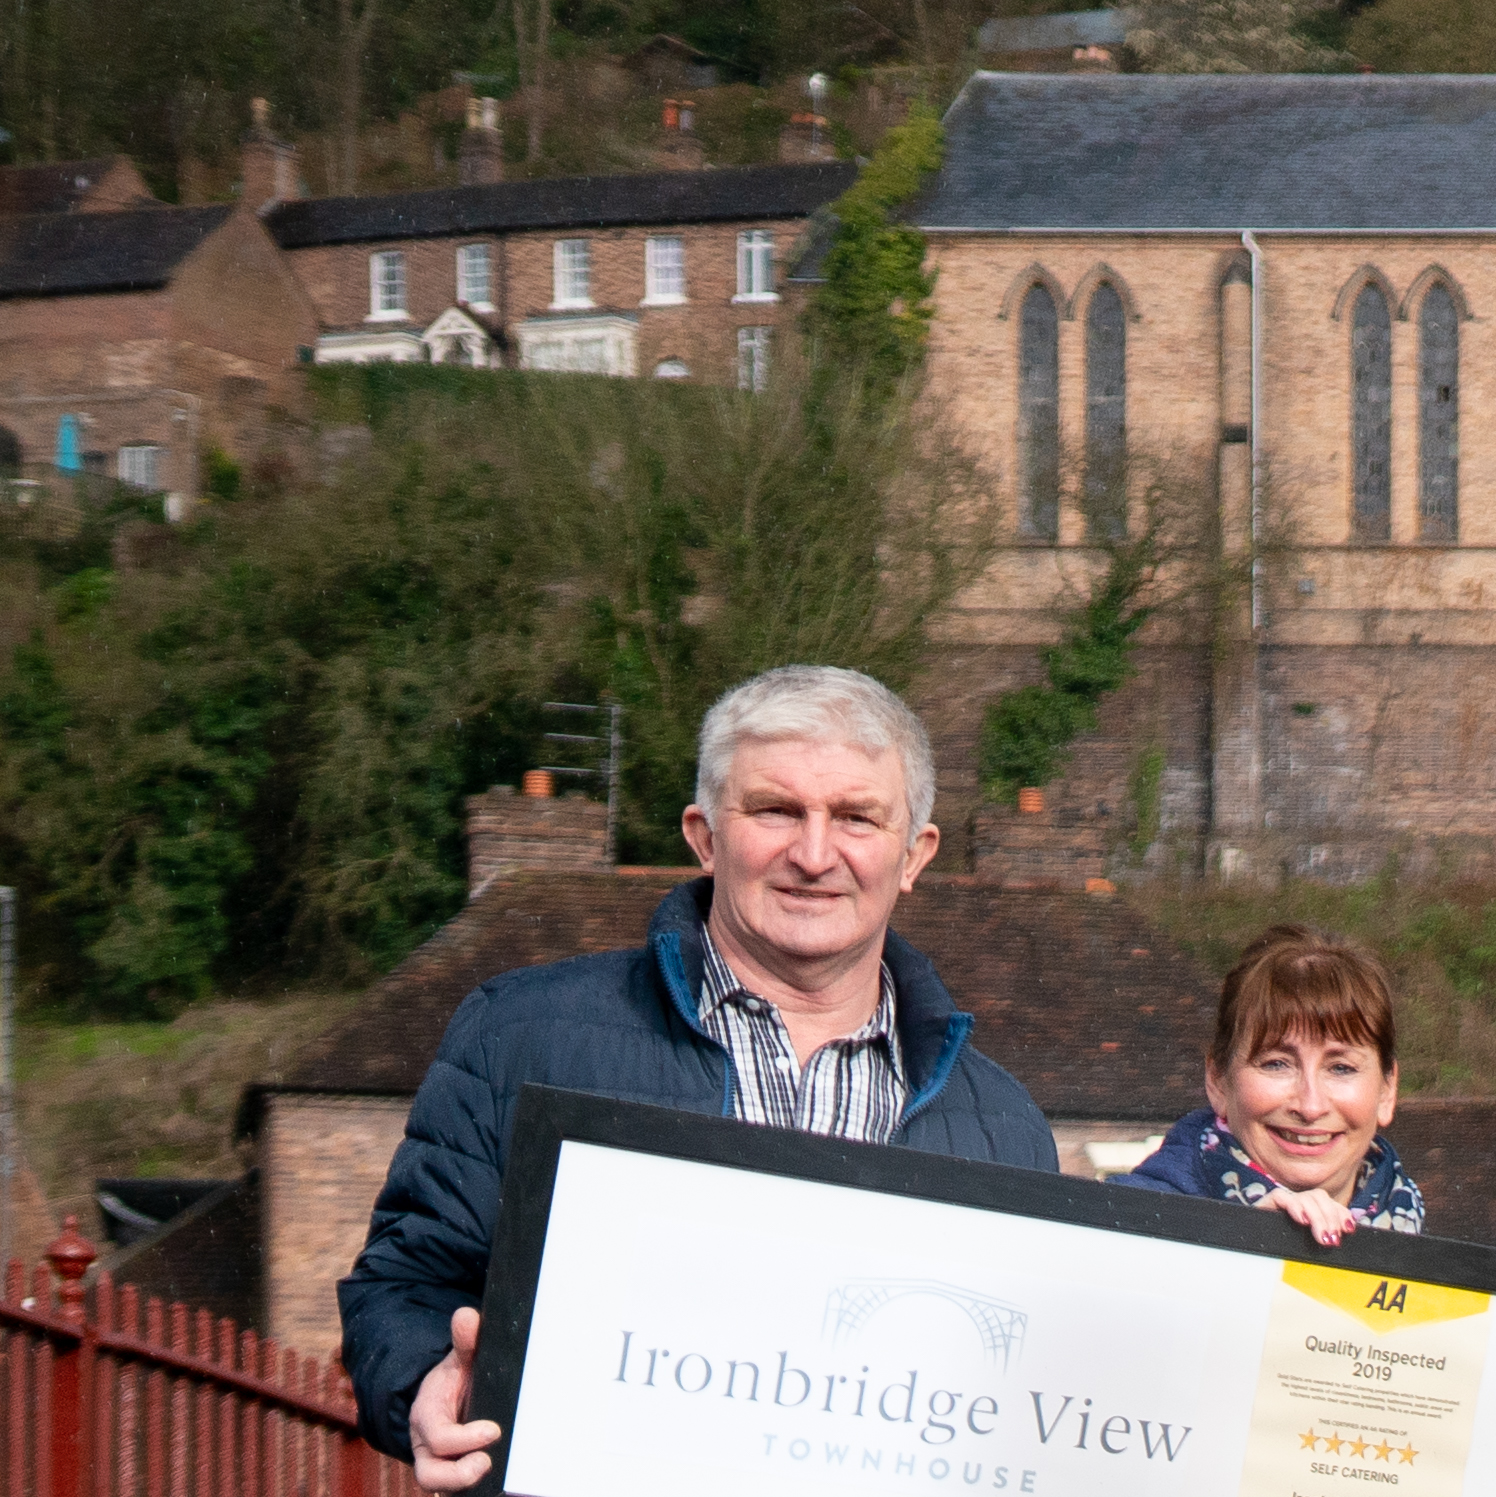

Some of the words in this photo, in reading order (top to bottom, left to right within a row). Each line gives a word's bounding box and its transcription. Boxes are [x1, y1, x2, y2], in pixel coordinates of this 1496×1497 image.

[1365, 1280, 1408, 1314] AA
[1305, 1335, 1363, 1360] Quality
[1367, 1345, 1447, 1371] Inspected
[1352, 1361, 1393, 1382] 2019
[612, 1330, 999, 1445] Ironbridge
[1028, 1389, 1193, 1463] View
[763, 1433, 1037, 1493] TOWNHOUSE
[1310, 1462, 1339, 1476] SELF
[1341, 1467, 1399, 1485] CATERING
